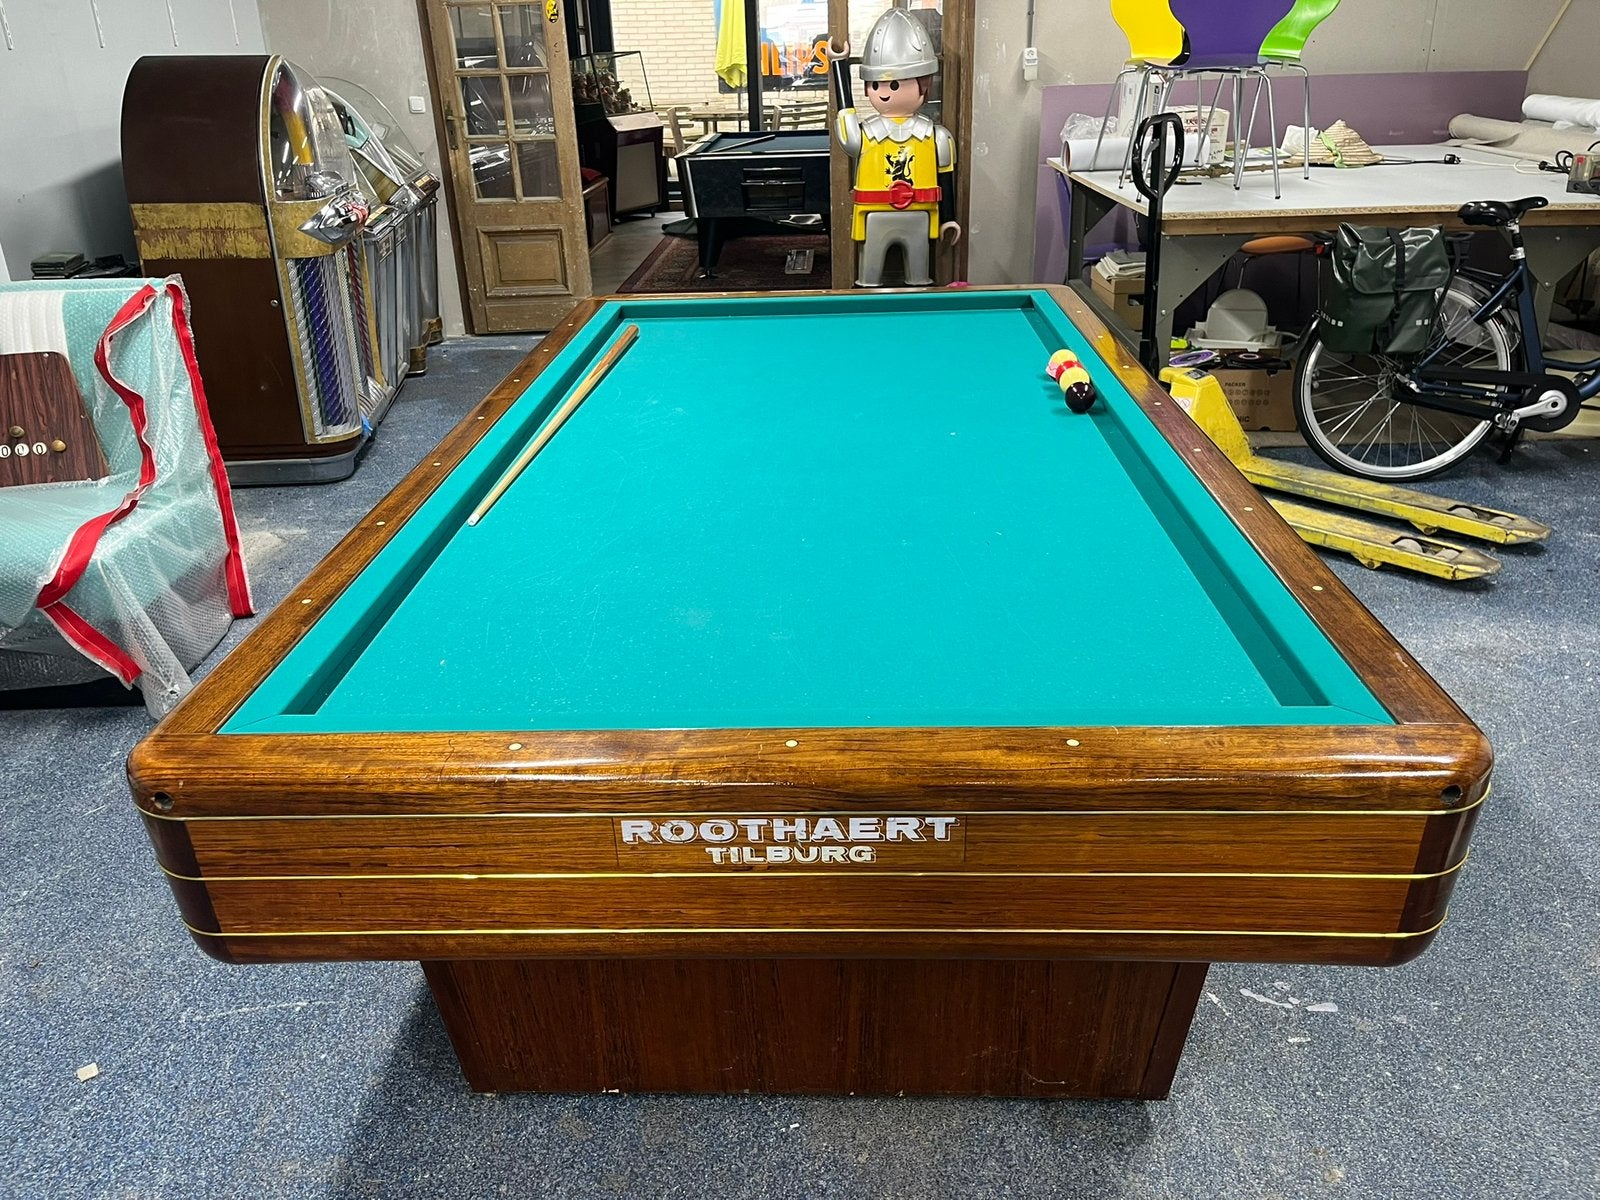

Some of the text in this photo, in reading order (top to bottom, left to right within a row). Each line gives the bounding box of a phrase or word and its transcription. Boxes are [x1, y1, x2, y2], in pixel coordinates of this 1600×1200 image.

[760, 40, 830, 76] ILIPS
[620, 816, 960, 845] ROOTHAERT
[705, 845, 876, 865] TILBURG
